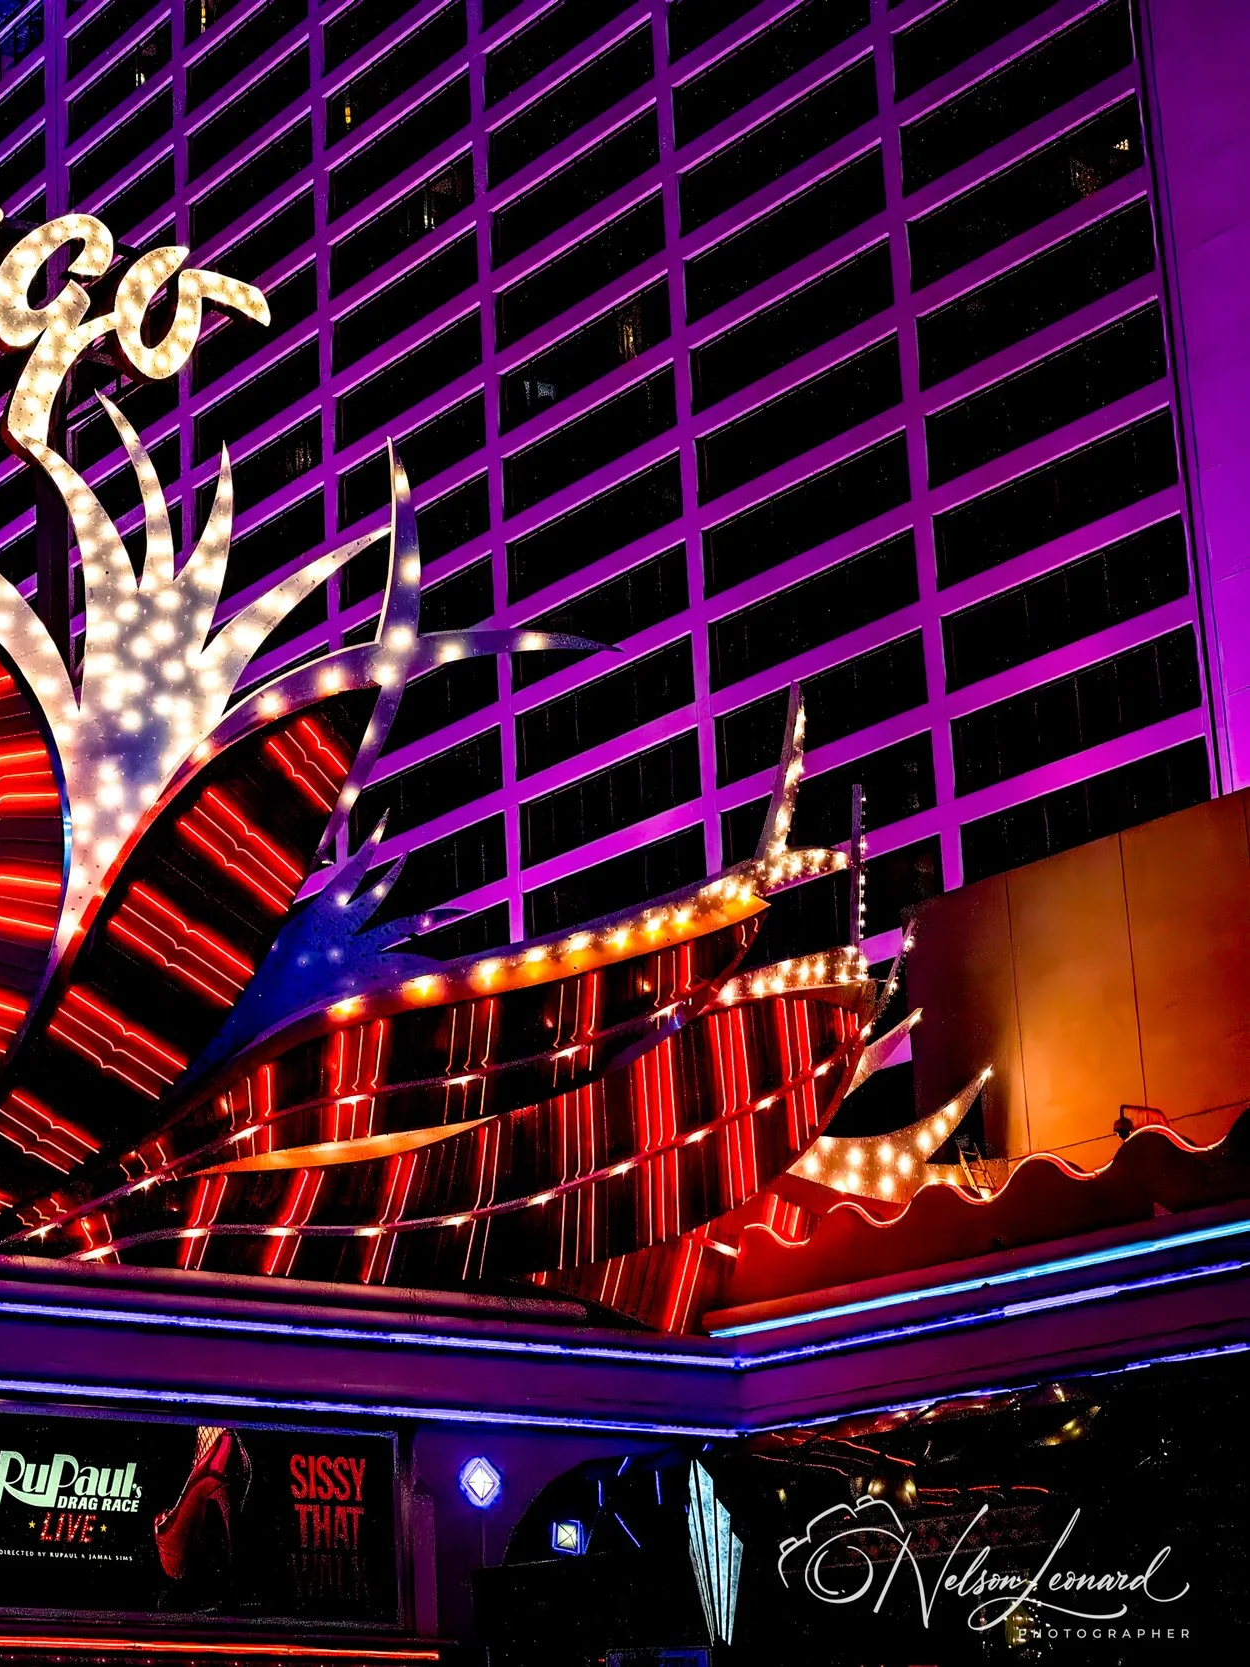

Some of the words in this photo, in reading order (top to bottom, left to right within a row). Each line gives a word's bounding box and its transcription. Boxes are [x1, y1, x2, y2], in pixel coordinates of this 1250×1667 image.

[290, 1454, 366, 1501] SISSY
[57, 1495, 99, 1511] DRAG
[101, 1498, 140, 1513] RACE
[40, 1511, 97, 1543] LIVE
[294, 1504, 365, 1550] THAT
[49, 1551, 78, 1560] RUPAUL
[88, 1553, 113, 1561] JAMAL
